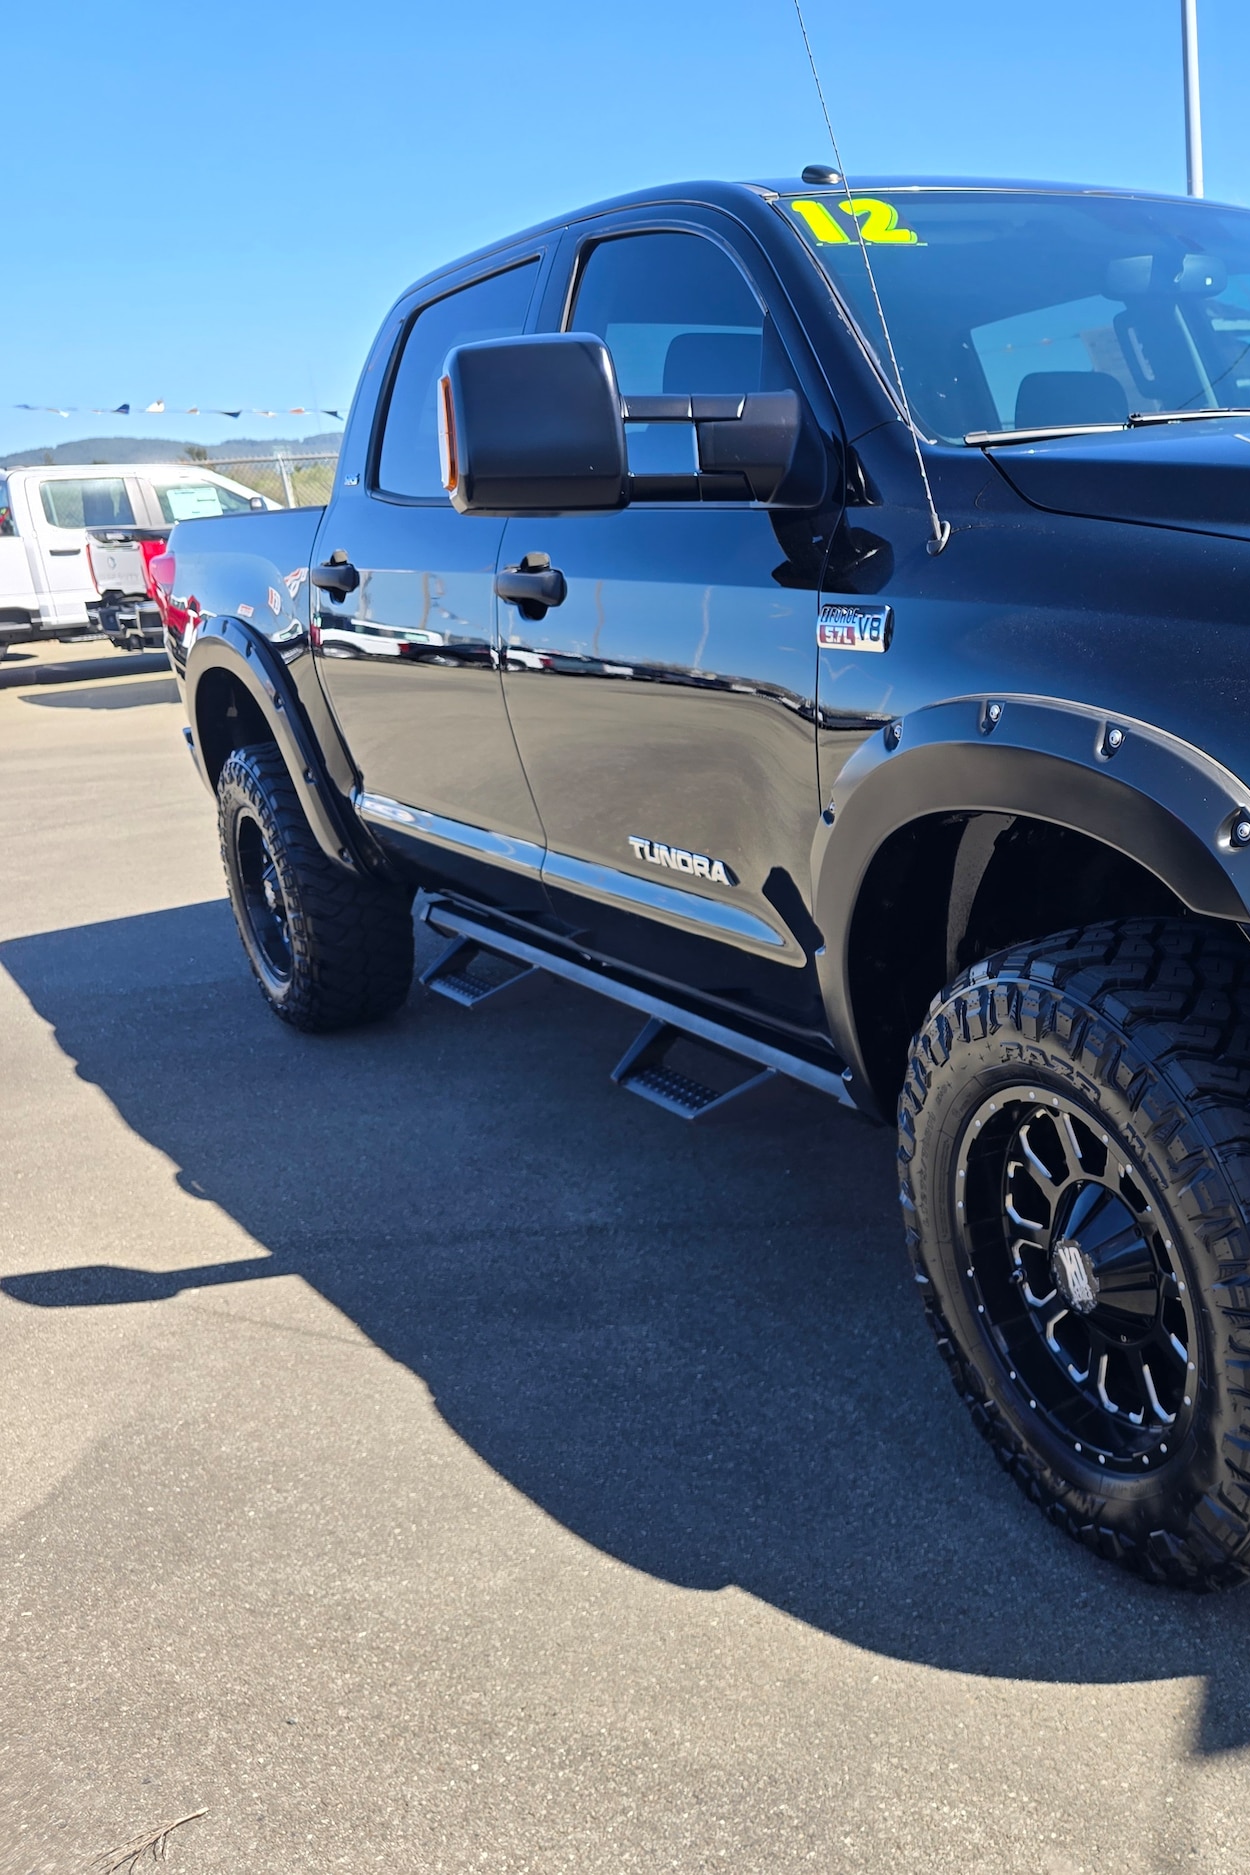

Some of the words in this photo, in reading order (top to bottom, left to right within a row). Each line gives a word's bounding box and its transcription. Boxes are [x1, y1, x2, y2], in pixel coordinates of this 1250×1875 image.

[791, 198, 918, 244] 12
[858, 614, 882, 642] V8
[628, 835, 732, 887] TUNDRA
